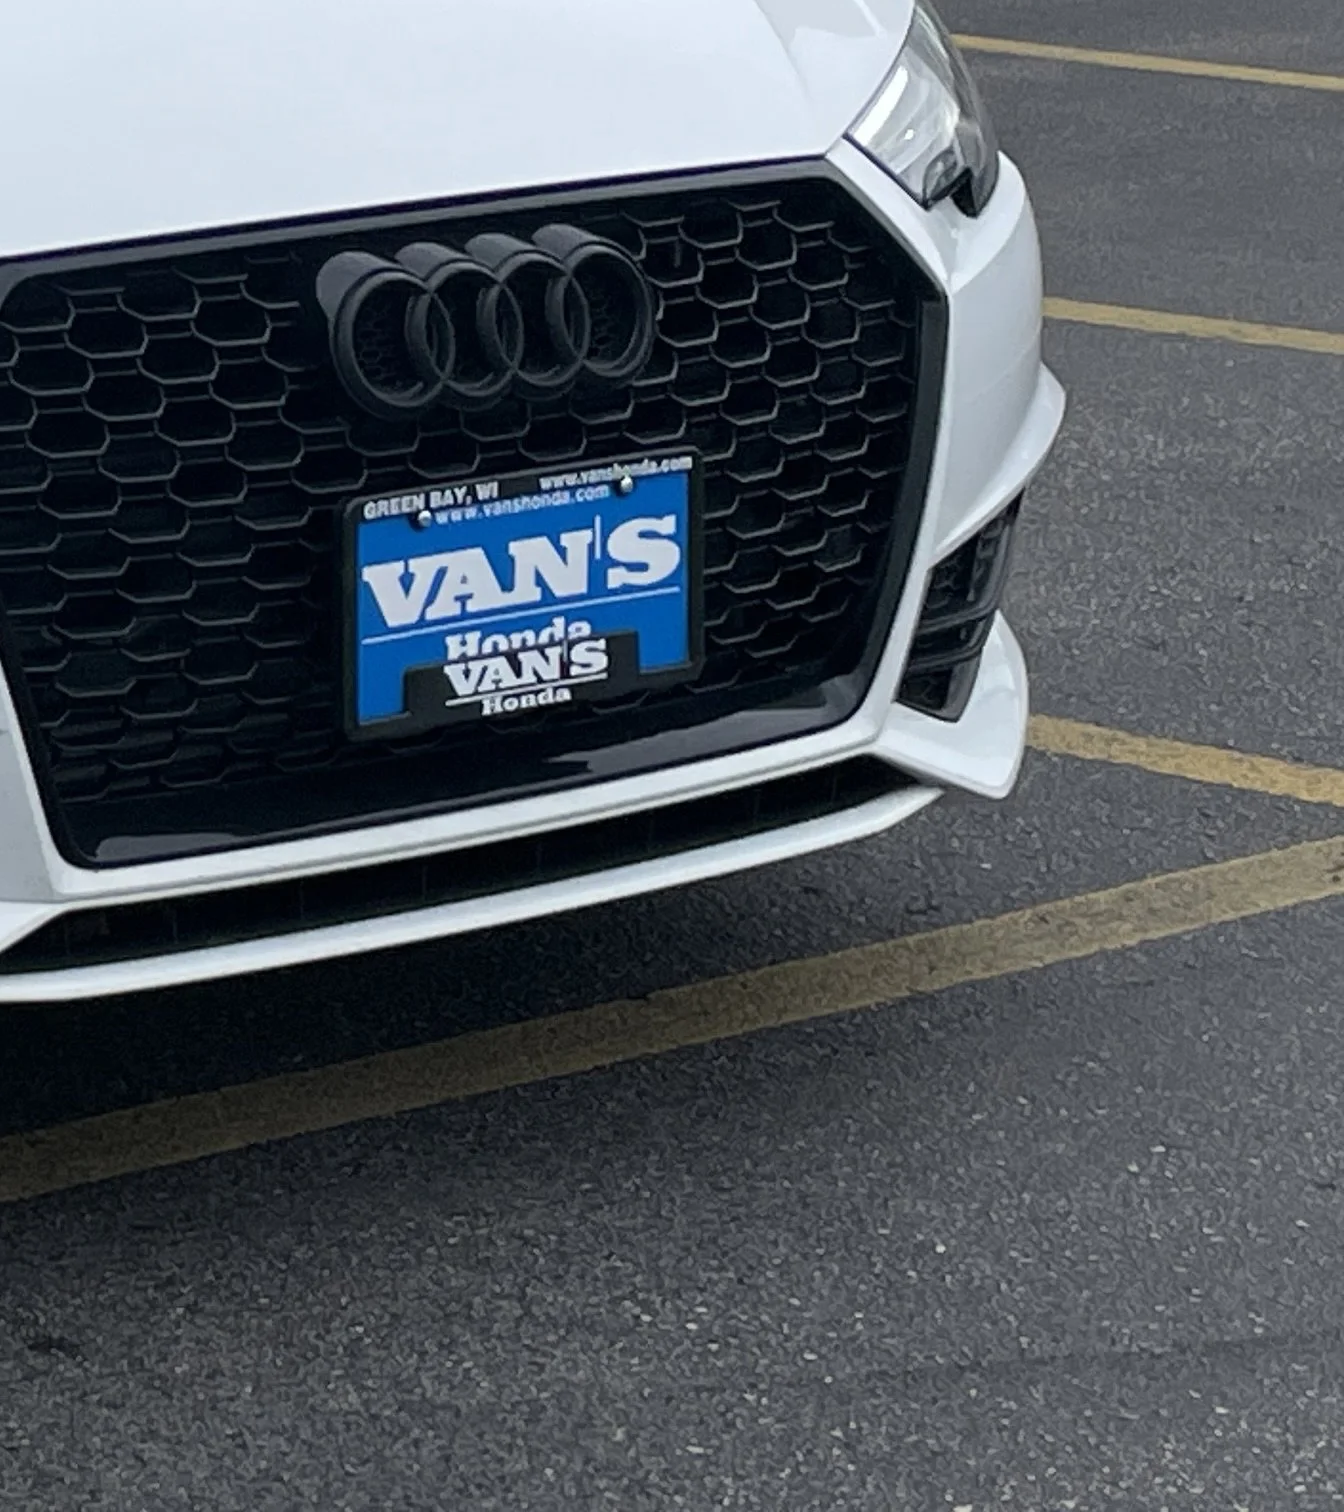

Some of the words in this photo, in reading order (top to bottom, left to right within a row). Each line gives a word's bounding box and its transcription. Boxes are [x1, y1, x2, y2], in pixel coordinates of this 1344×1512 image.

[364, 492, 425, 521] GREEN
[429, 486, 471, 511] BAY,
[476, 482, 499, 499] WI
[362, 514, 681, 628] VAN'S
[445, 616, 592, 661] Honda
[443, 638, 609, 697] VAN'S
[481, 686, 572, 717] Honda
